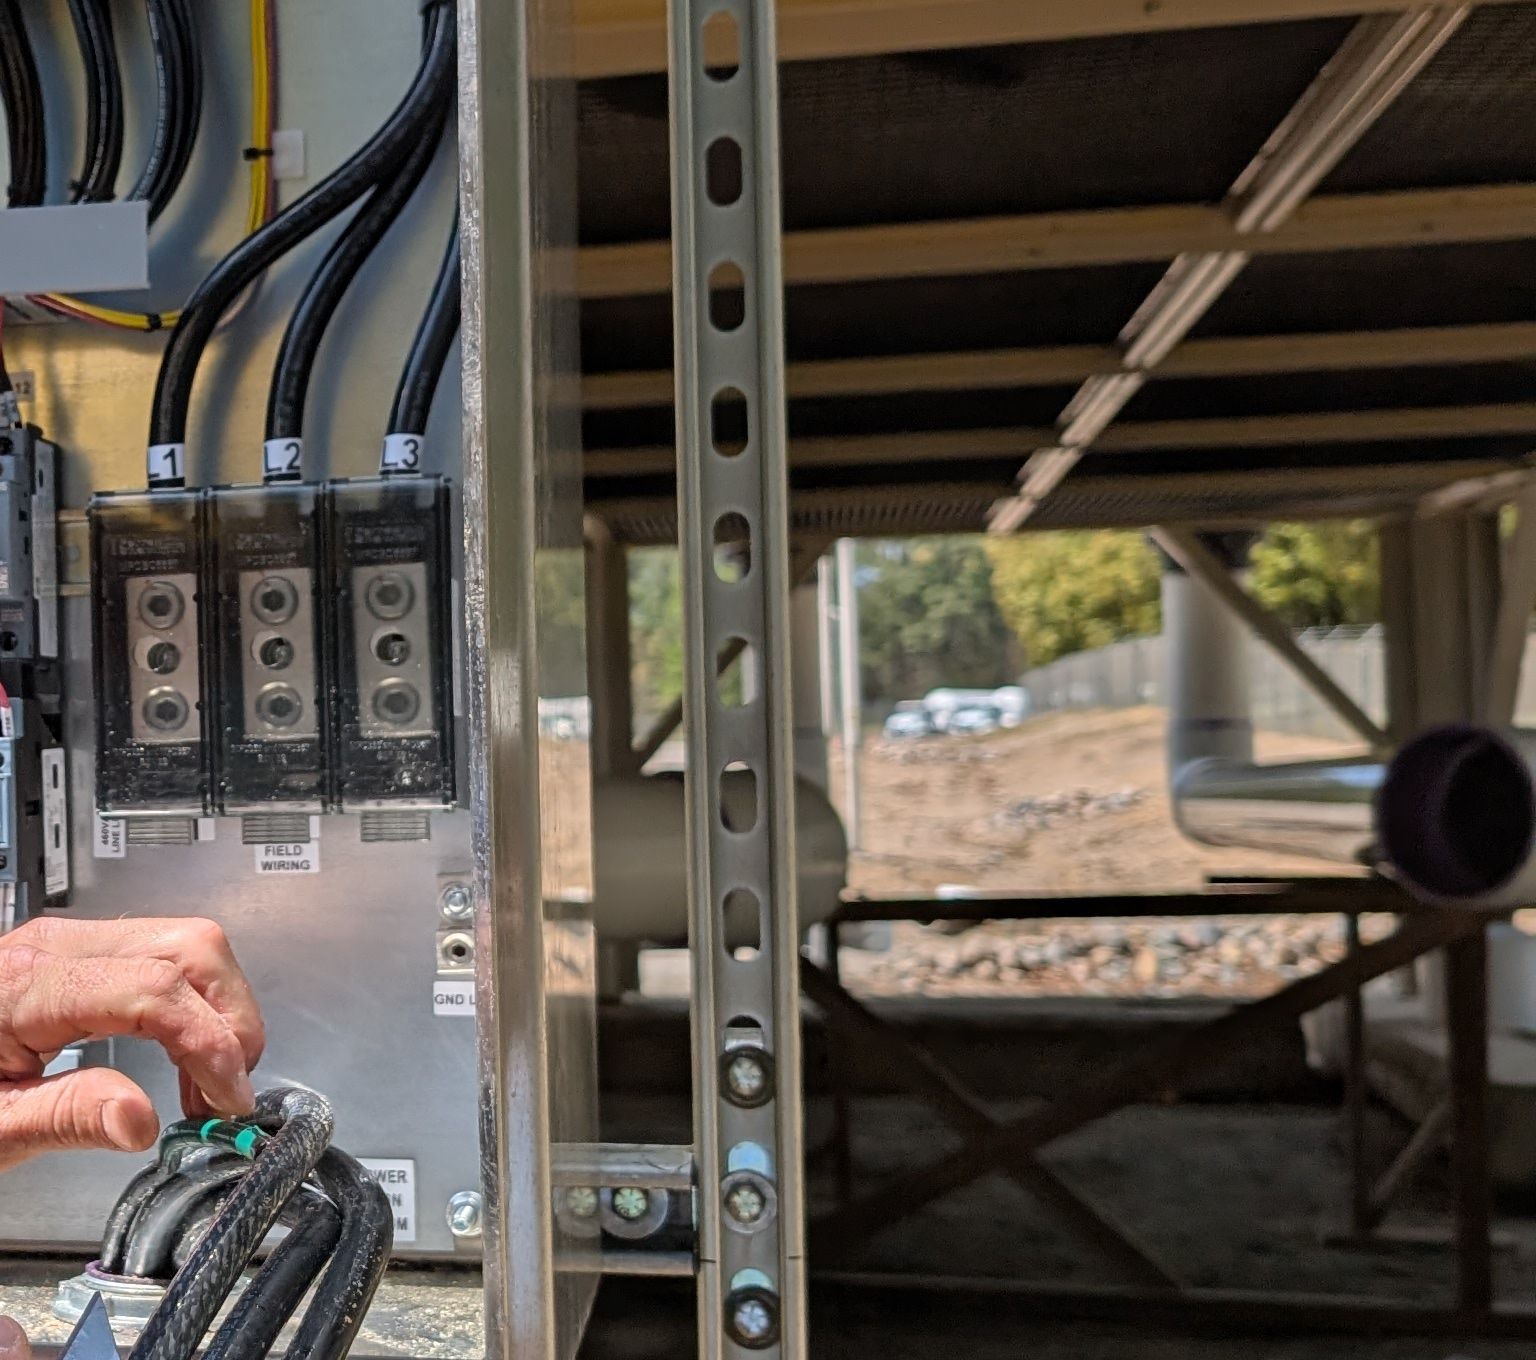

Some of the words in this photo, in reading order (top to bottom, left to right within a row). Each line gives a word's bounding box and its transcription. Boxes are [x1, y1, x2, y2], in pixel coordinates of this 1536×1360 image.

[264, 442, 301, 473] L2
[382, 439, 419, 469] L3
[112, 830, 120, 853] LINE
[265, 845, 303, 856] FIELD
[261, 860, 311, 872] WIRING
[434, 993, 464, 1005] GND
